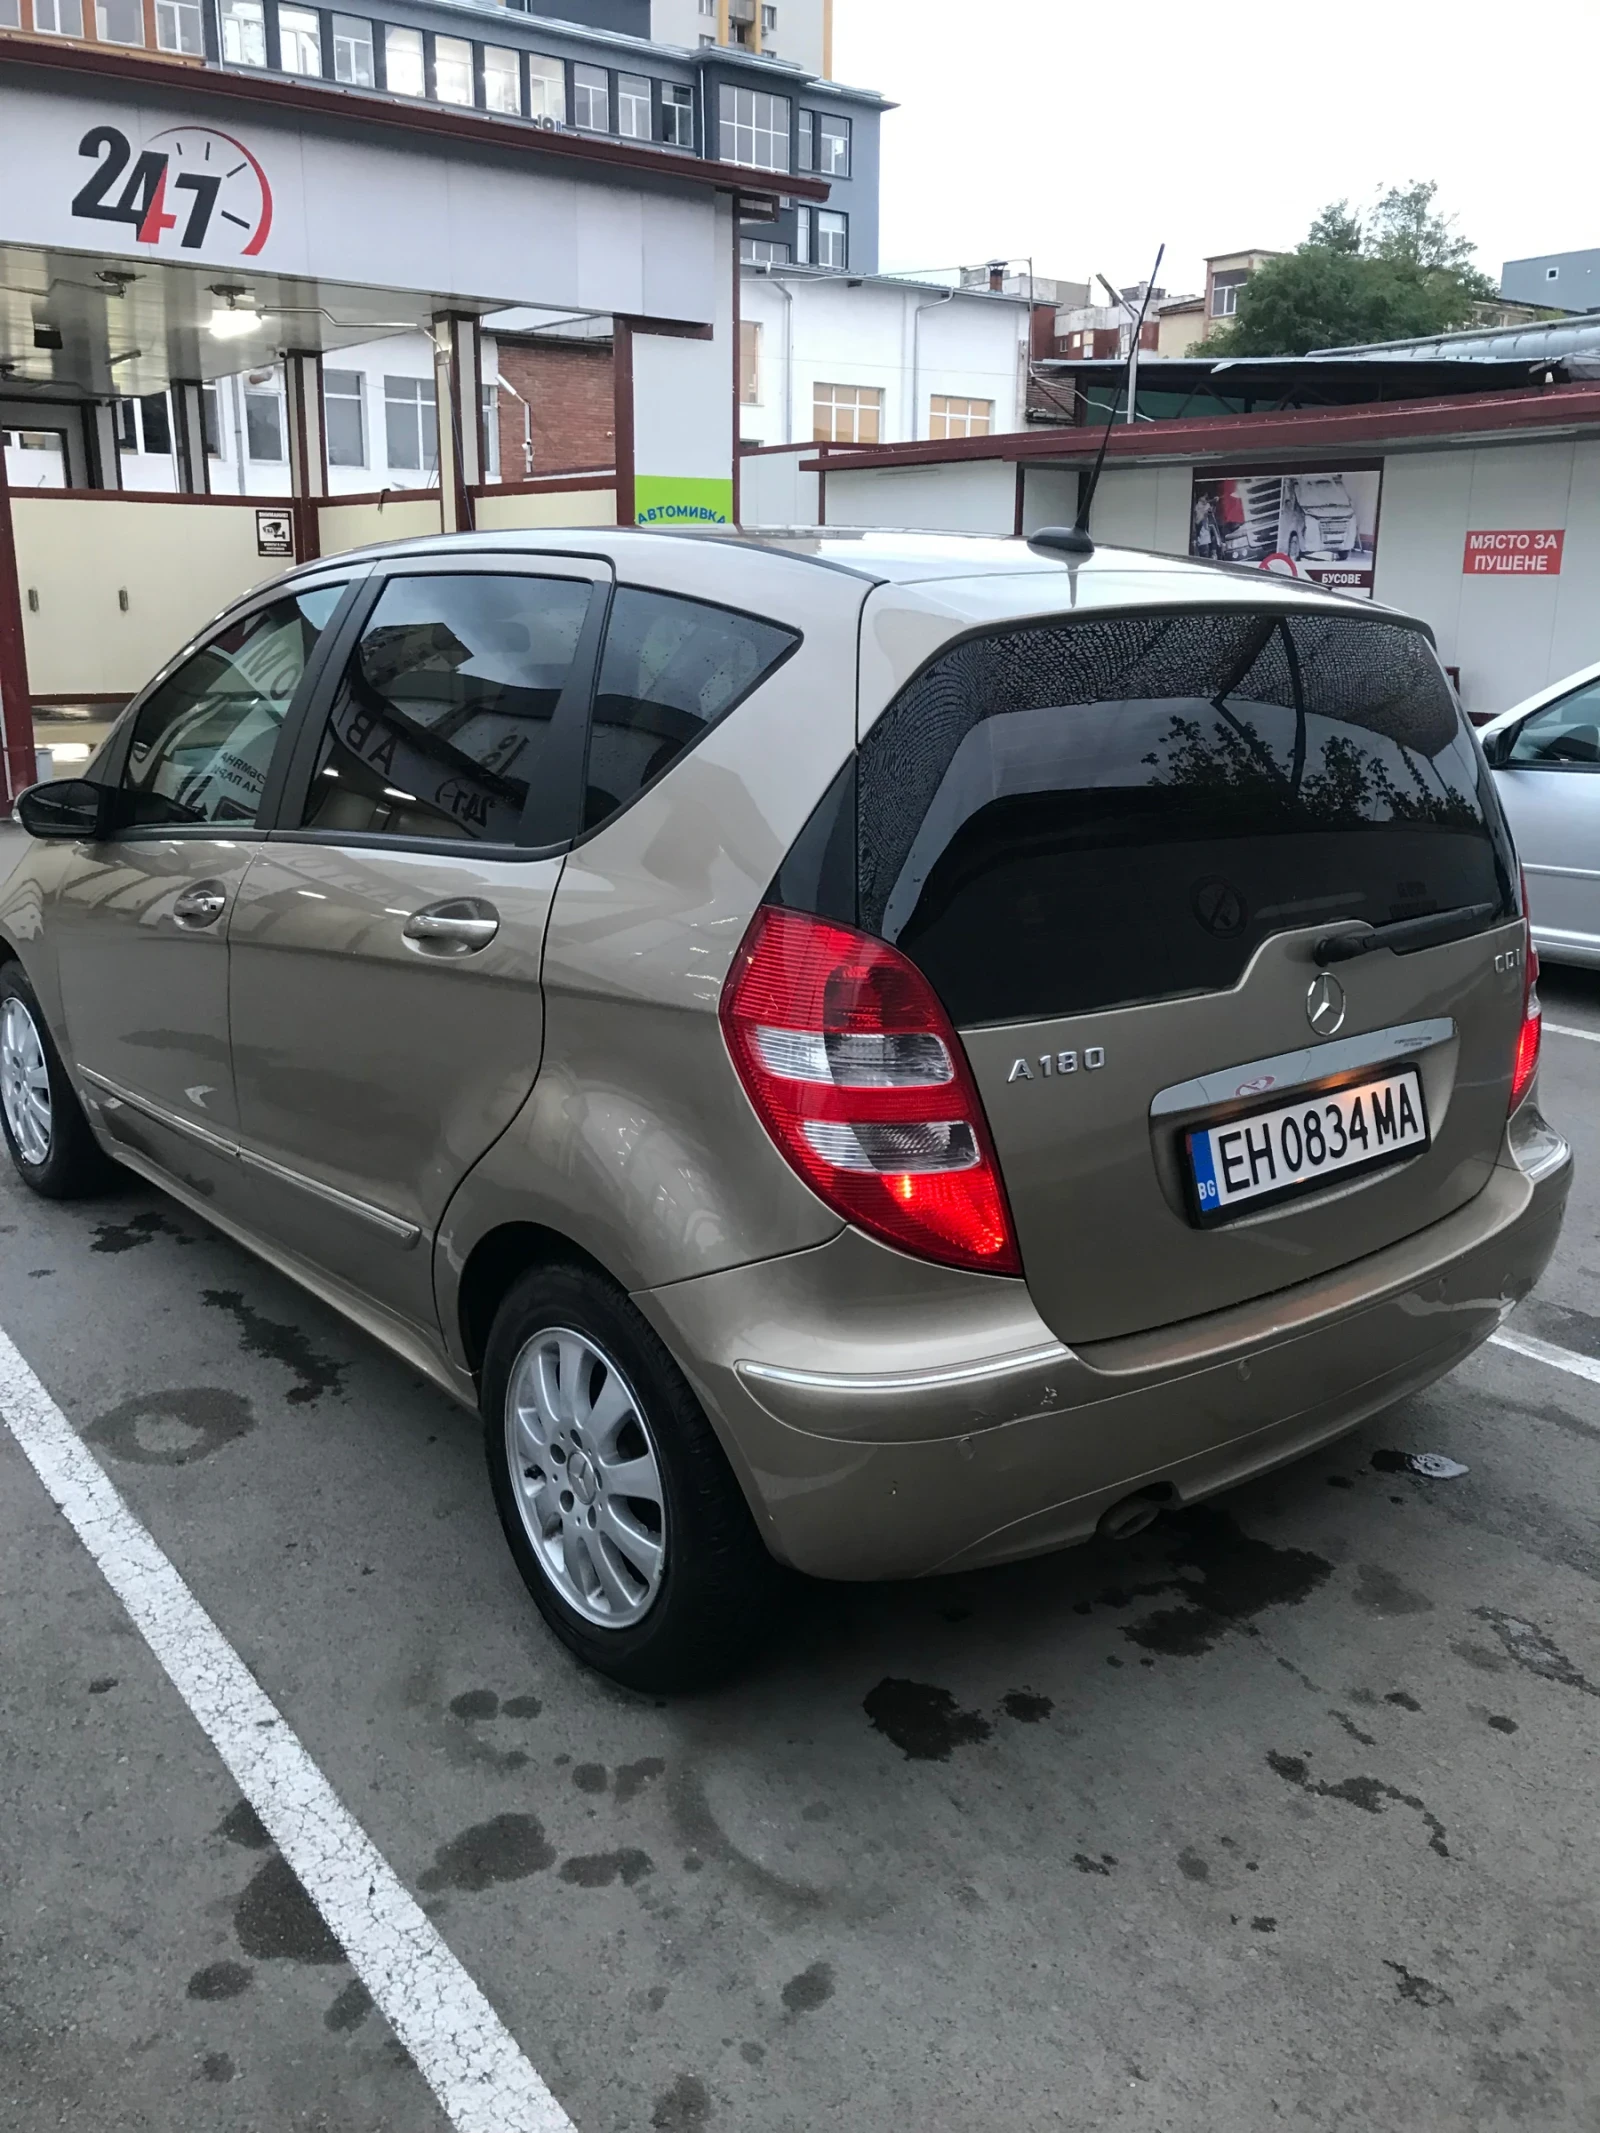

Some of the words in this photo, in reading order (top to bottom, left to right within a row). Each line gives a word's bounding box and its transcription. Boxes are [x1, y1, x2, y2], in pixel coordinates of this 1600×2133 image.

[637, 505, 726, 525] АВТОМИВКА
[1469, 534, 1530, 549] МЯСТО
[1533, 534, 1558, 549] ЗА
[1474, 554, 1549, 571] ПУШЕНЕ
[1321, 573, 1362, 585] БУСОВЕ
[1494, 948, 1520, 973] CDI
[1198, 1182, 1217, 1200] BG
